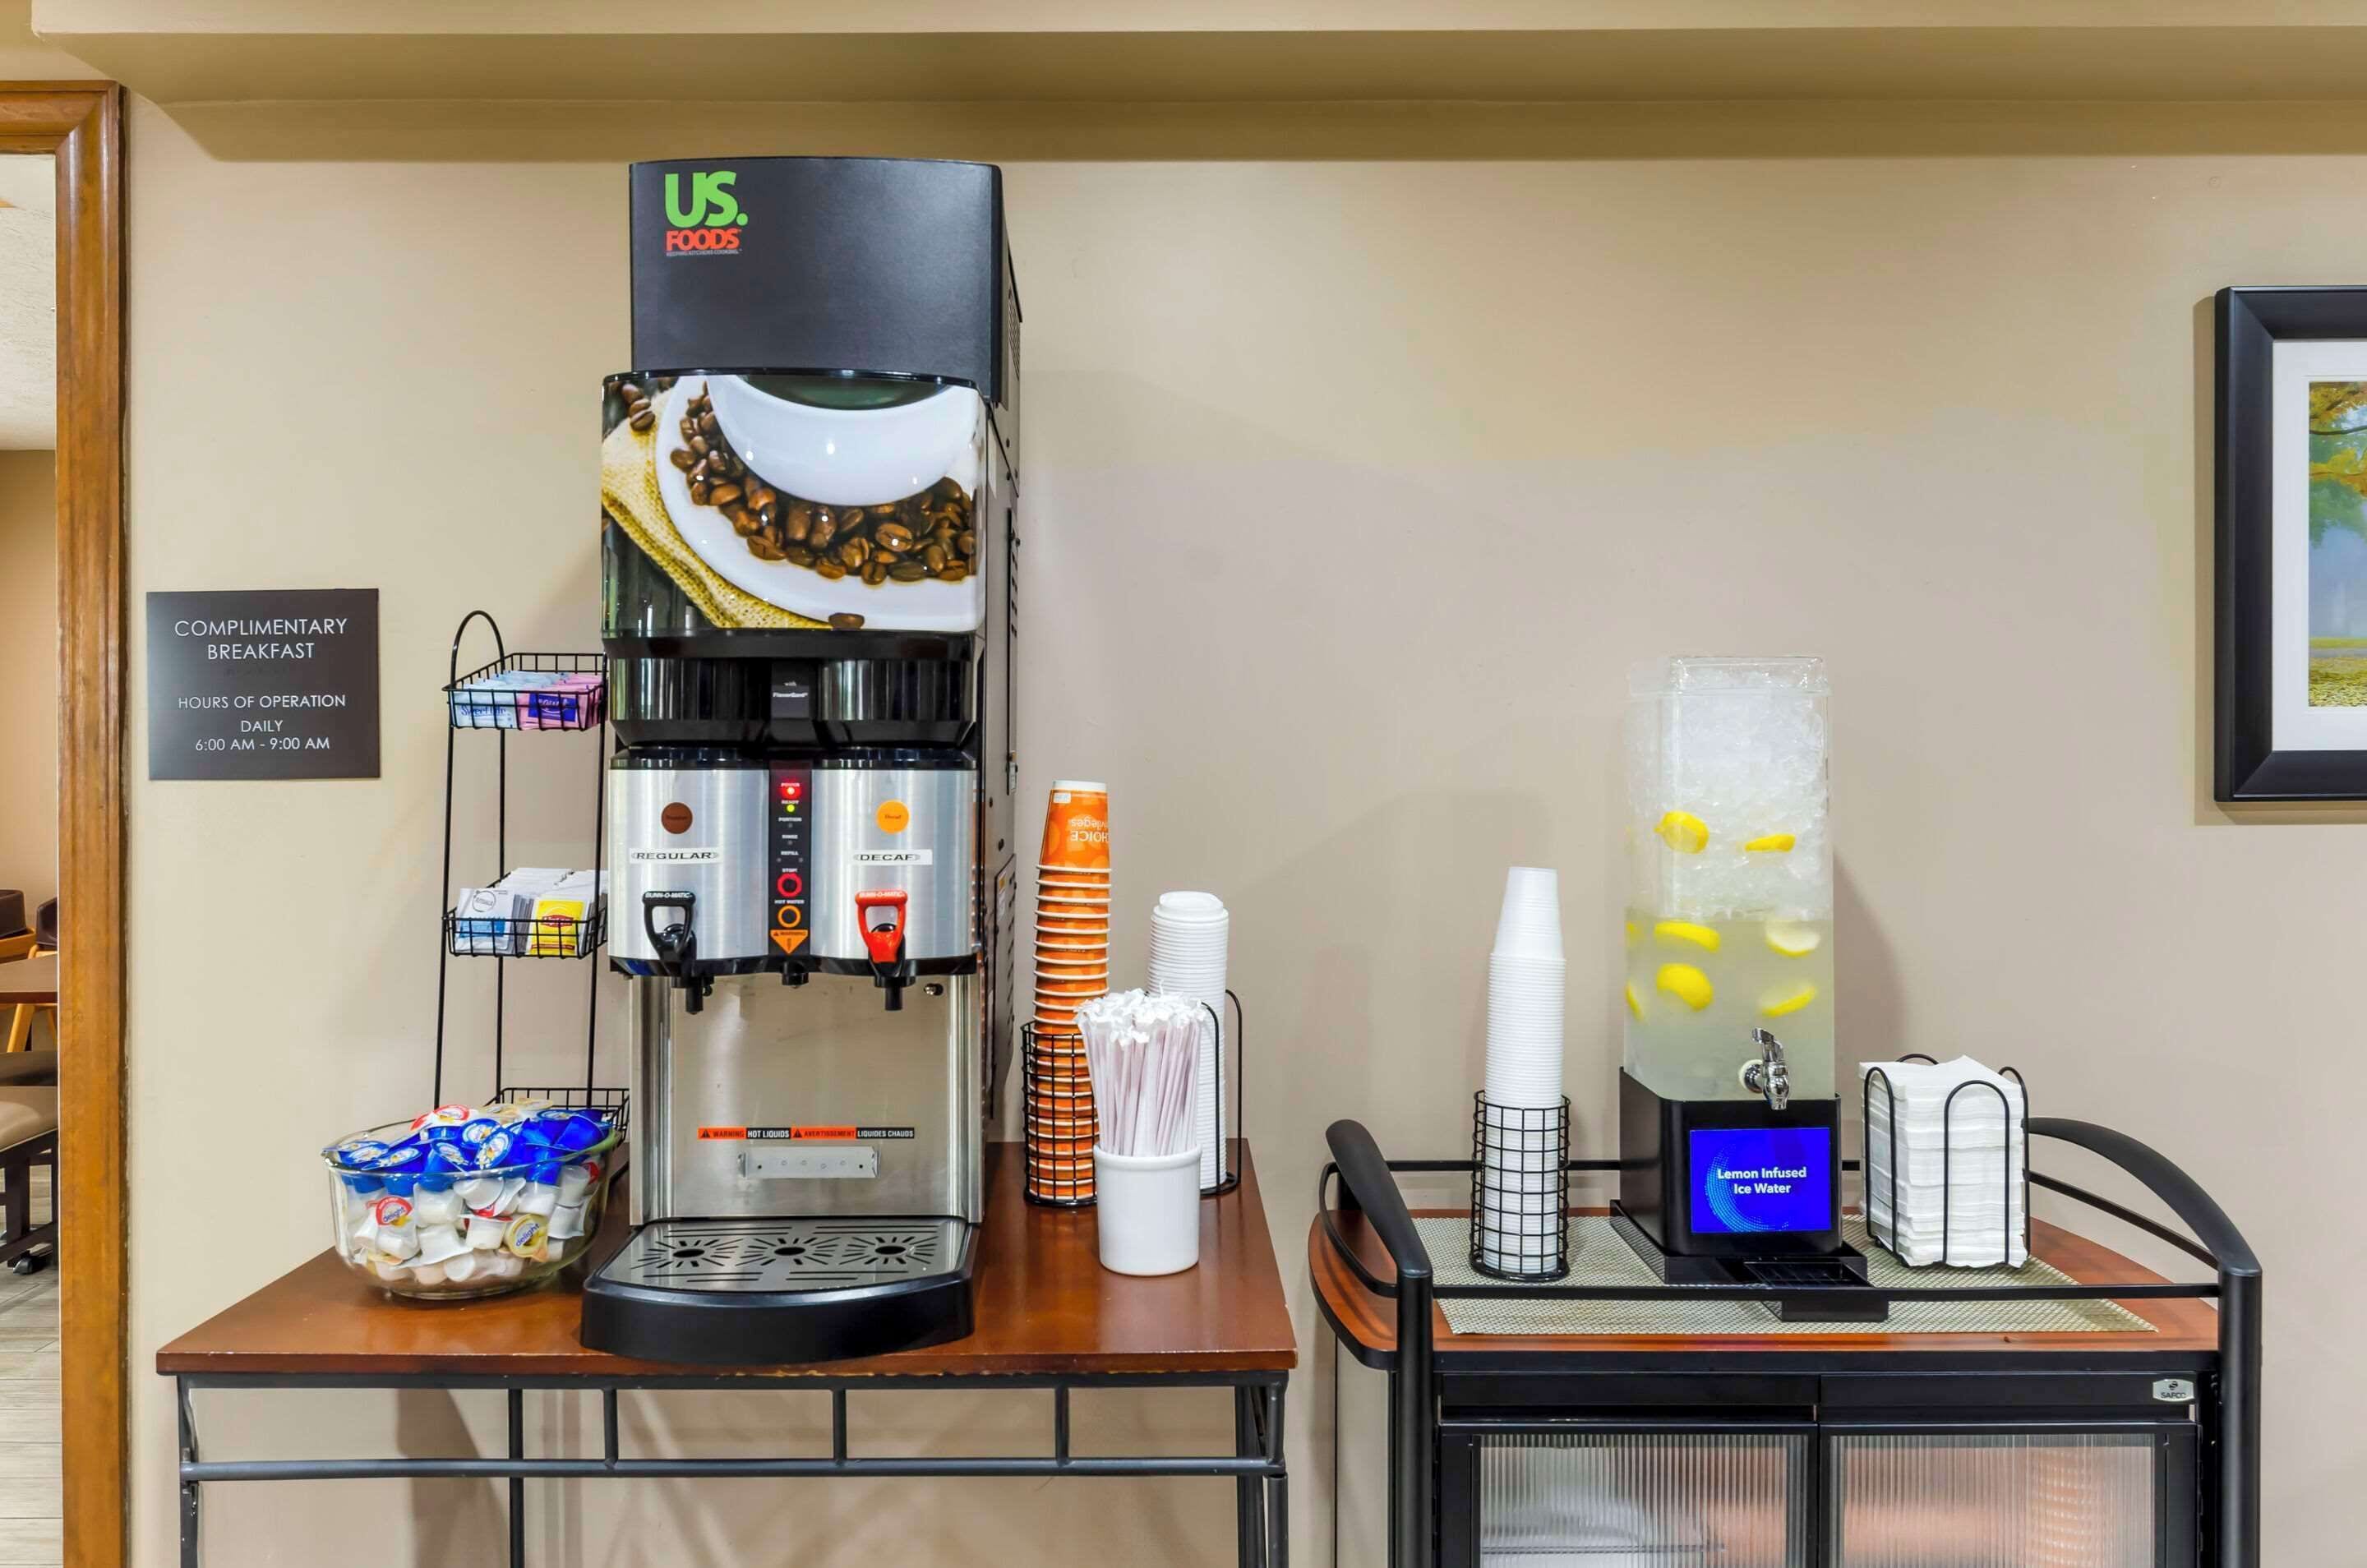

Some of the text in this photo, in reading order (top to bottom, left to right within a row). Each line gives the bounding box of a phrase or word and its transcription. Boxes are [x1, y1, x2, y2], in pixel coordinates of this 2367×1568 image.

[665, 170, 749, 228] US.
[666, 228, 741, 251] FOODS
[174, 618, 348, 637] COMPLIMENTARY
[207, 643, 315, 660] BREAKFAST
[178, 694, 346, 709] HOURS OF OPERATION
[240, 720, 284, 733] DAILY
[195, 739, 225, 751] 6:00
[230, 738, 255, 750] AM
[270, 737, 300, 749] 9:00
[305, 737, 330, 749] AM
[1070, 830, 1109, 842] HOICE
[636, 851, 713, 860] REGULAR
[713, 1130, 745, 1139] WARNING
[747, 1130, 761, 1138] HOT
[763, 1130, 790, 1138] LIQUIDS
[857, 1130, 886, 1138] LIQUIDES
[888, 1130, 913, 1138] CHAUDS
[1716, 1166, 1807, 1180] Lemon Infused
[1733, 1183, 1792, 1194] Ice Water
[383, 1206, 406, 1223] delight
[515, 1222, 541, 1247] delight
